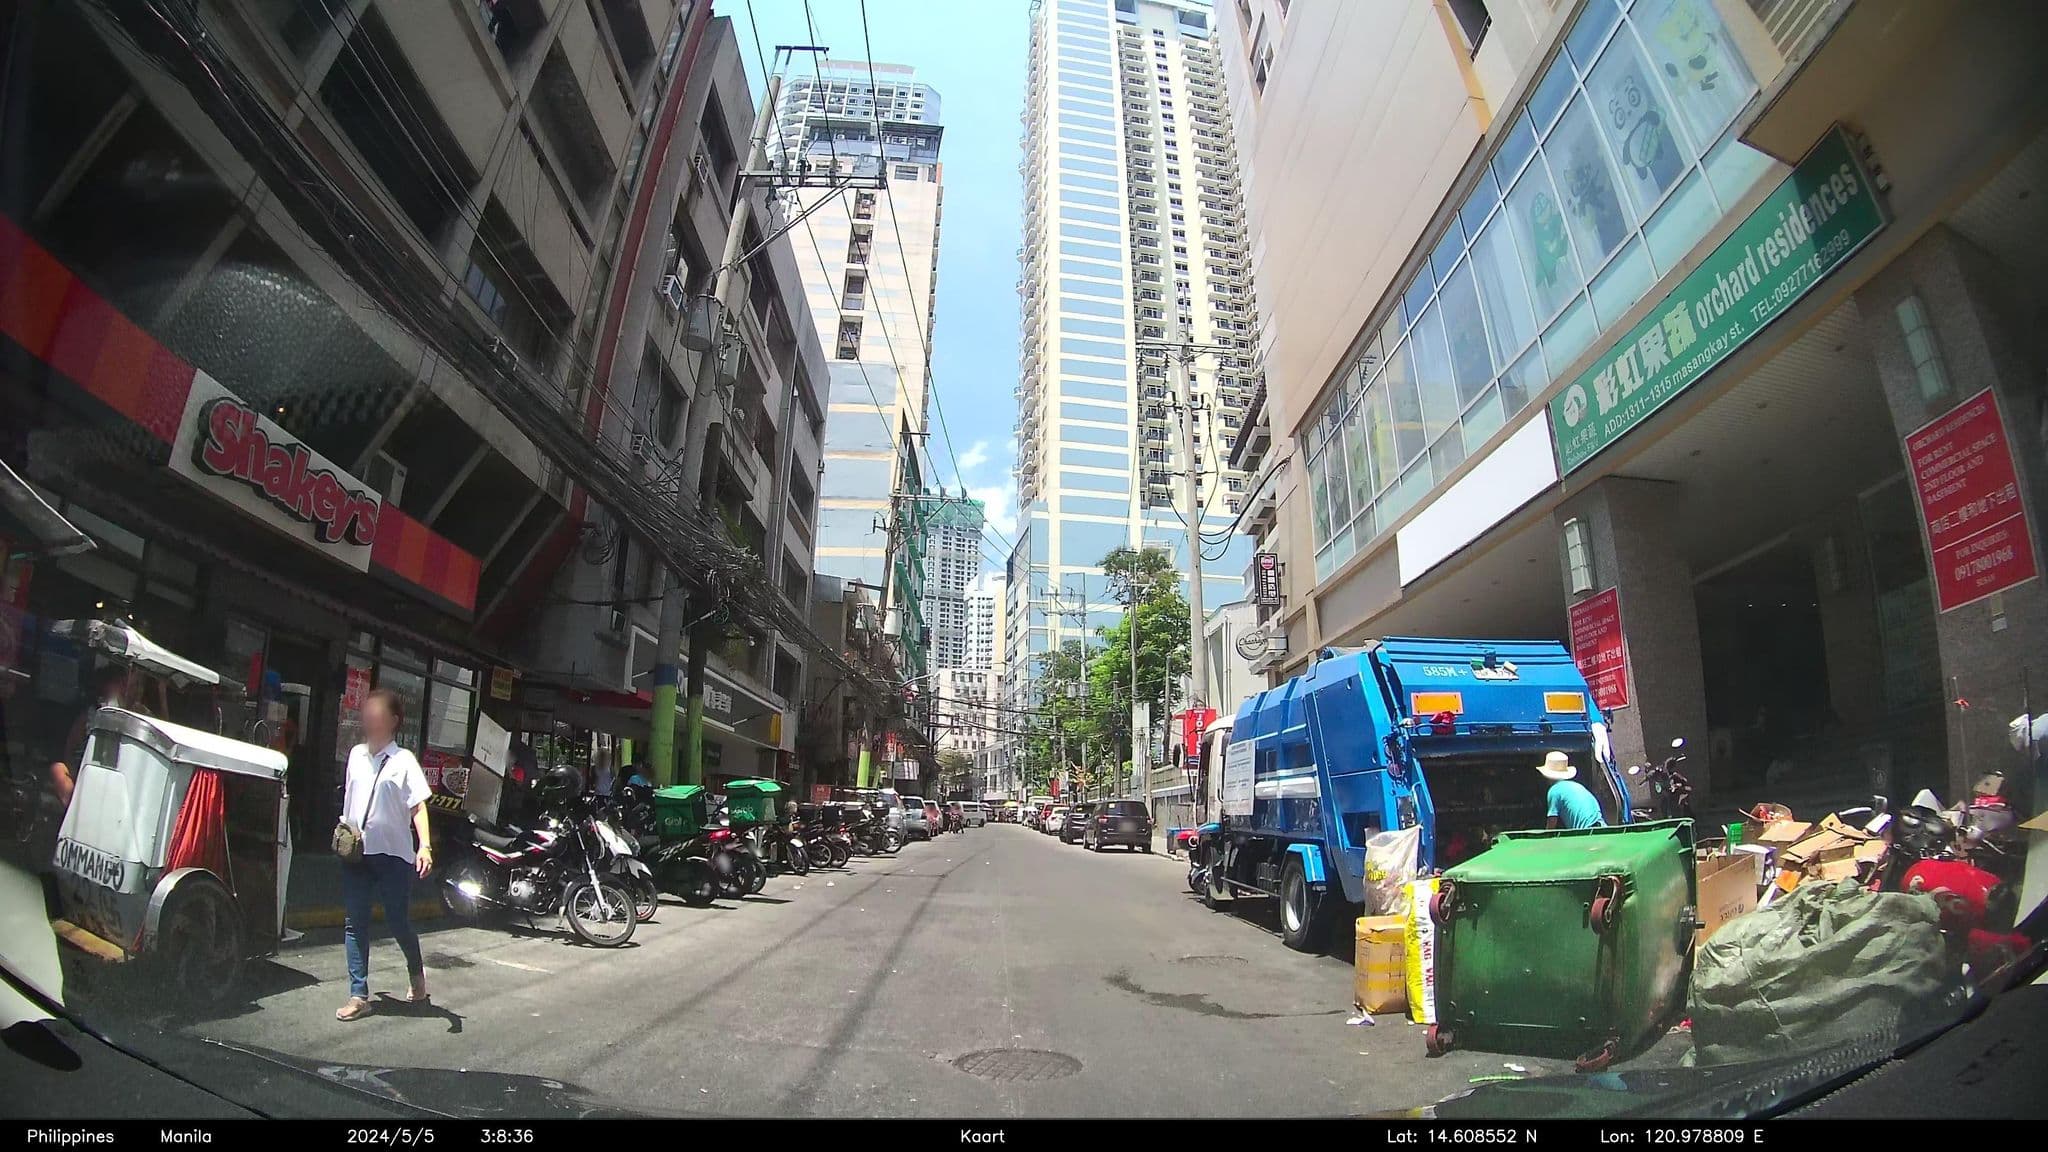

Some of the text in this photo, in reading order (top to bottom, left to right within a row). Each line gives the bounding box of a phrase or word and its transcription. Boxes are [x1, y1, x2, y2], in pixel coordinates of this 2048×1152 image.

[1696, 163, 1858, 329] orchard residences
[1672, 333, 1728, 385] masangkay
[1729, 321, 1745, 339] st.
[1749, 229, 1850, 322] TEL:09277162999
[1592, 300, 1697, 416] 彩虹果蔬
[195, 398, 377, 545] Shakey's
[1918, 441, 1954, 468] FOR RENT
[1920, 432, 1998, 480] COMMERCIAL SPACE
[1926, 478, 1968, 505] BASEMENT
[1940, 465, 1966, 487] FLOOR
[1966, 454, 1985, 473] AND
